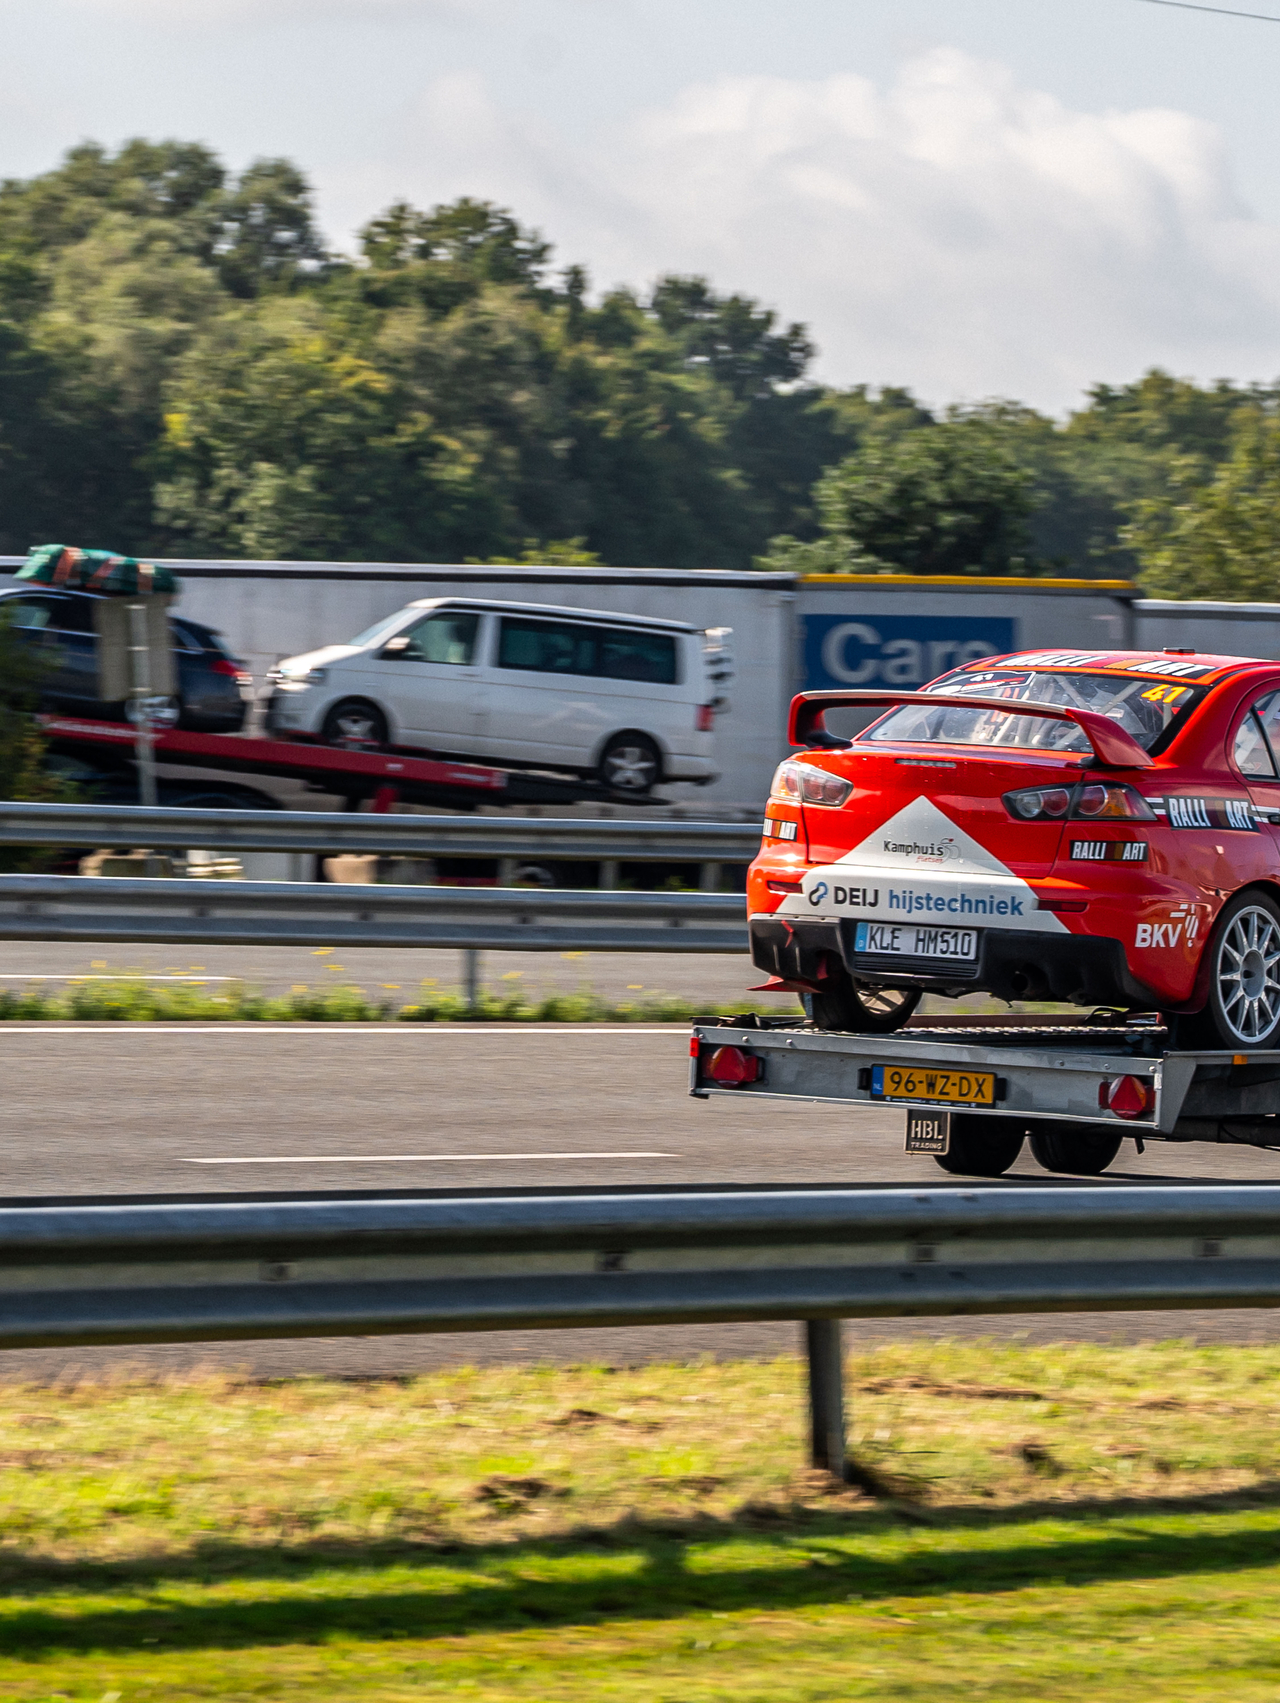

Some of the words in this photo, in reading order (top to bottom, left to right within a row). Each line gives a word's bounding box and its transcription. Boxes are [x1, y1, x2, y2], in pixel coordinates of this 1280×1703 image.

[995, 654, 1107, 667] RALLI
[1126, 660, 1216, 677] ART
[1140, 683, 1188, 703] 41
[1168, 798, 1212, 827] RALLI
[1225, 801, 1253, 829] ART
[883, 840, 944, 856] Kamphuis
[1072, 842, 1106, 860] RALLI
[1122, 843, 1146, 860] ART
[833, 886, 879, 907] DEIJ
[889, 889, 1024, 916] hijstechniek
[868, 926, 902, 951] KLE
[914, 930, 971, 956] HM510
[1134, 923, 1182, 948] BKV
[890, 1071, 986, 1098] 96-WZ-DX
[911, 1120, 943, 1140] HBL
[911, 1141, 942, 1149] TRADING
